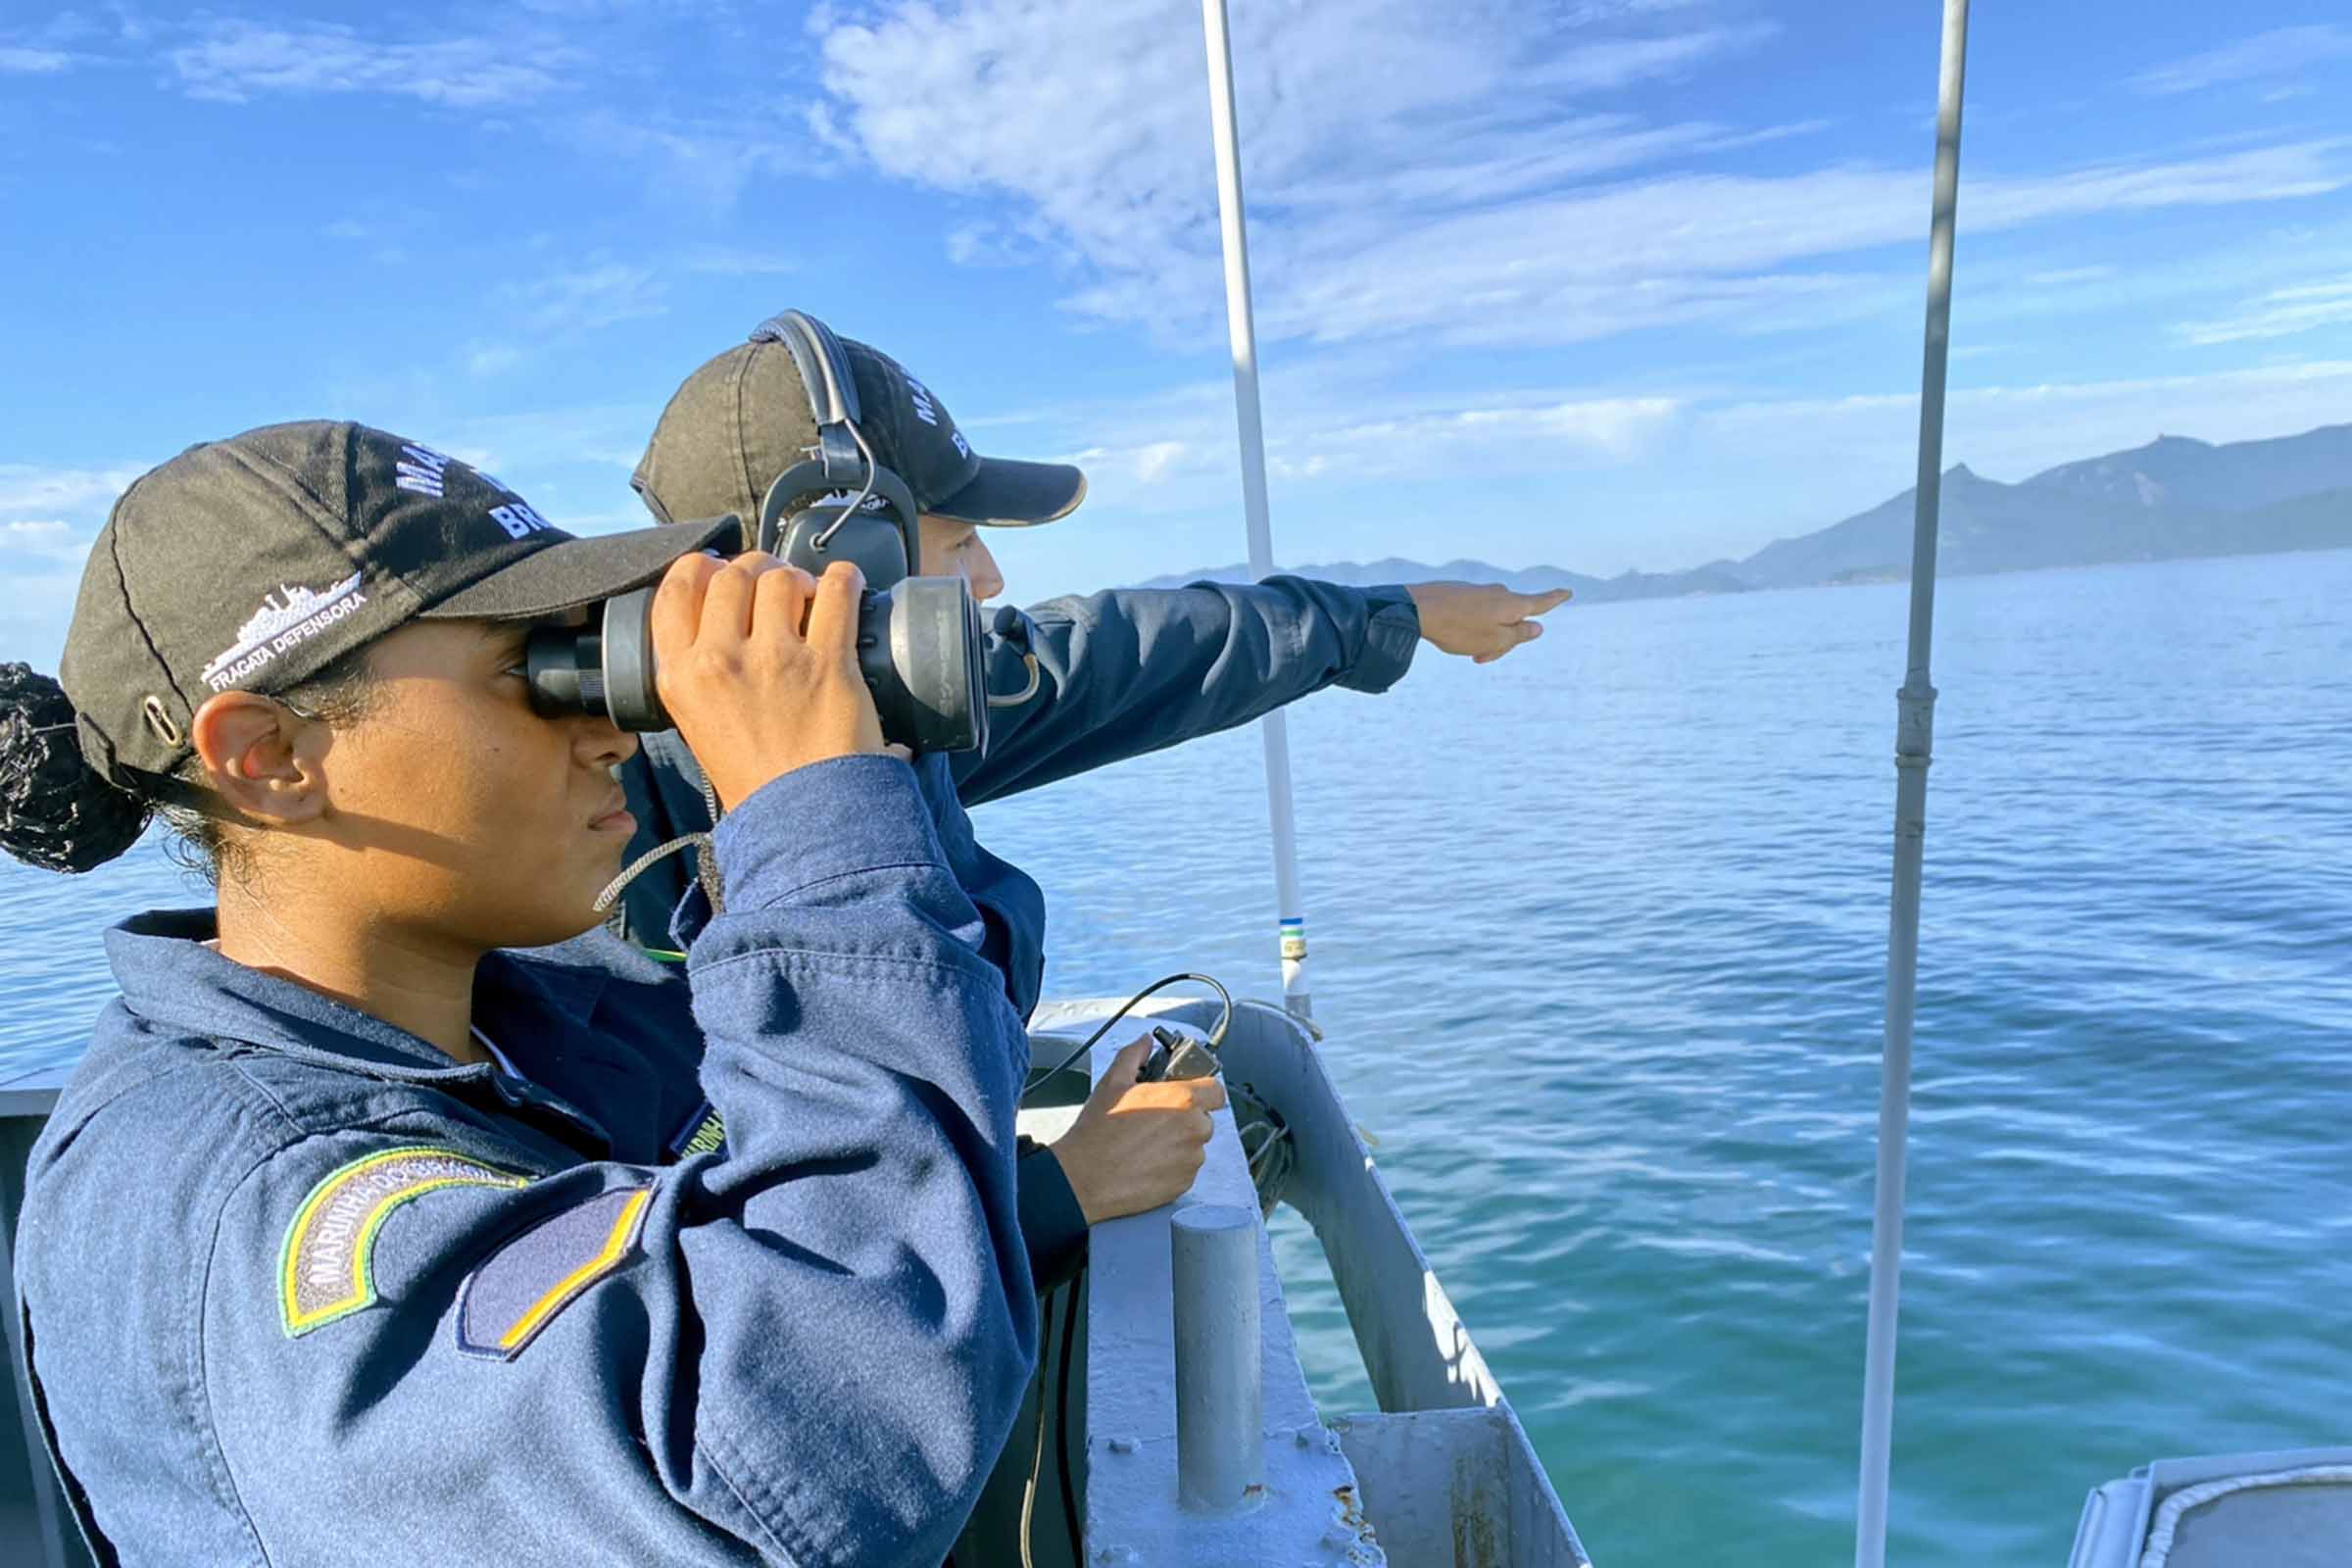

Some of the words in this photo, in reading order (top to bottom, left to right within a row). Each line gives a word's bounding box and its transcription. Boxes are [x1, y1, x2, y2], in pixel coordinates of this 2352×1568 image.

[209, 647, 274, 692] FRAGATA
[272, 591, 368, 654] DEFENSORA
[309, 1187, 373, 1285] MARINHA
